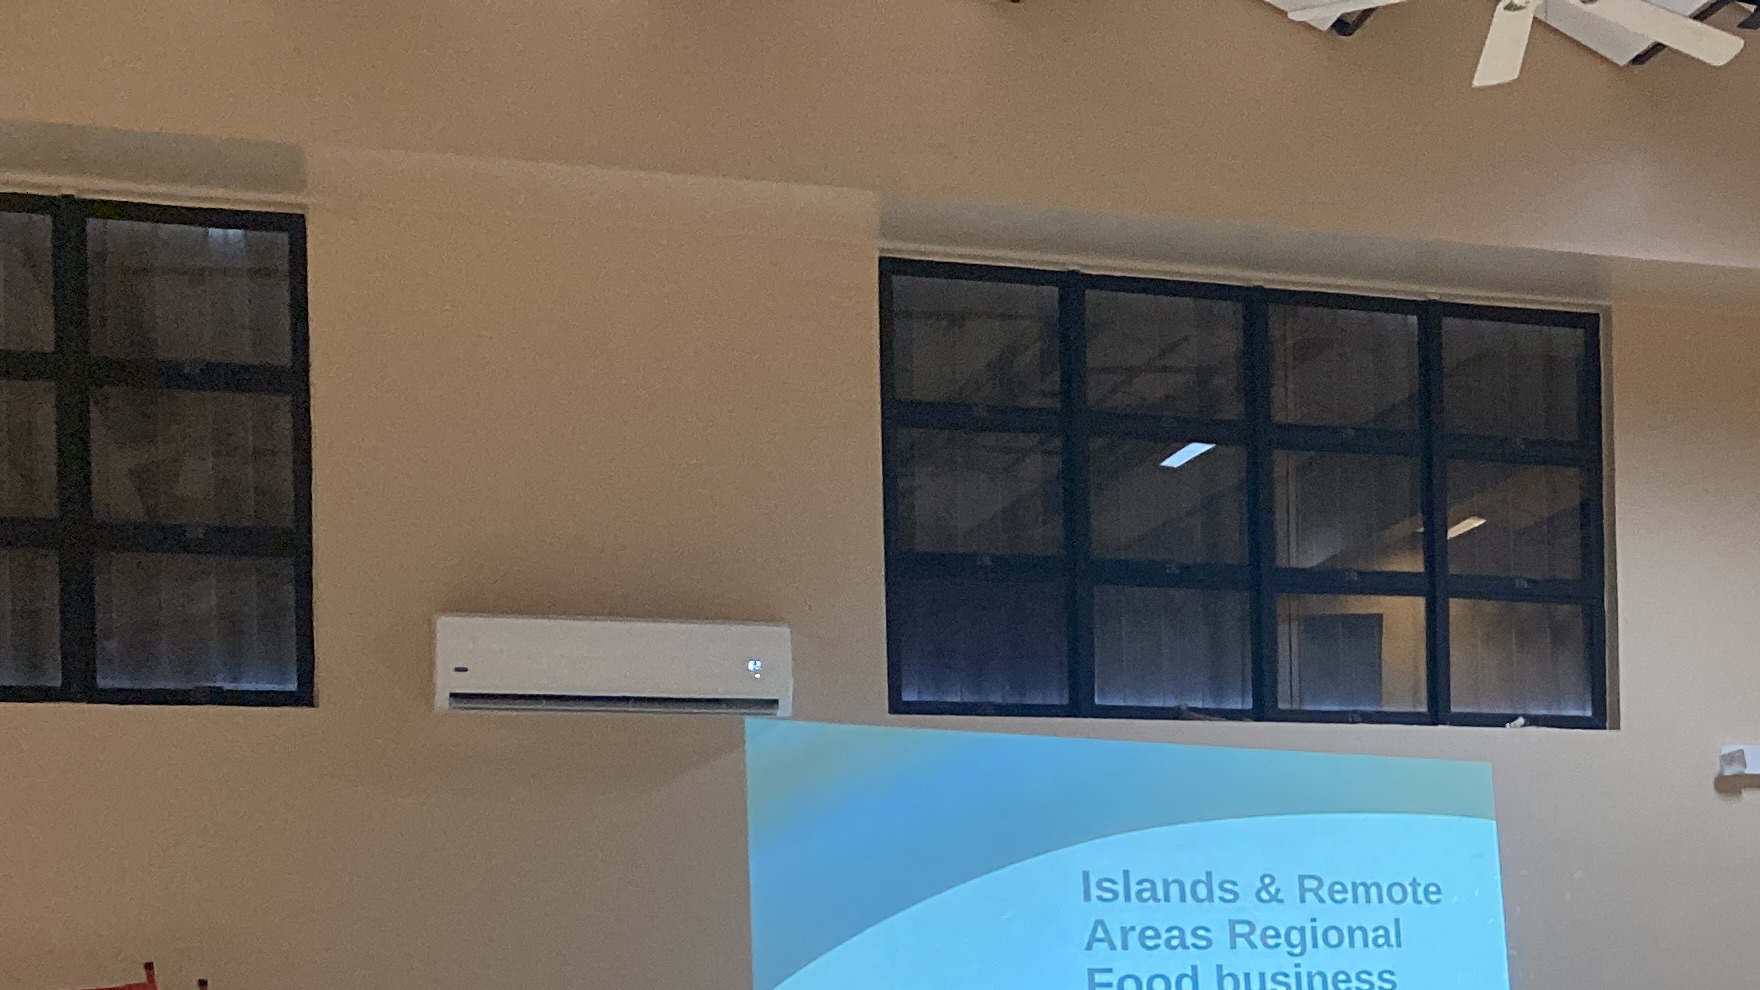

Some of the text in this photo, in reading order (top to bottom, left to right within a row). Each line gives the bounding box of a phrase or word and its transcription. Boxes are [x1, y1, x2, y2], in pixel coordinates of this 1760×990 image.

[1082, 869, 1443, 905] Islands & Remote
[1085, 918, 1402, 957] Areas Regional
